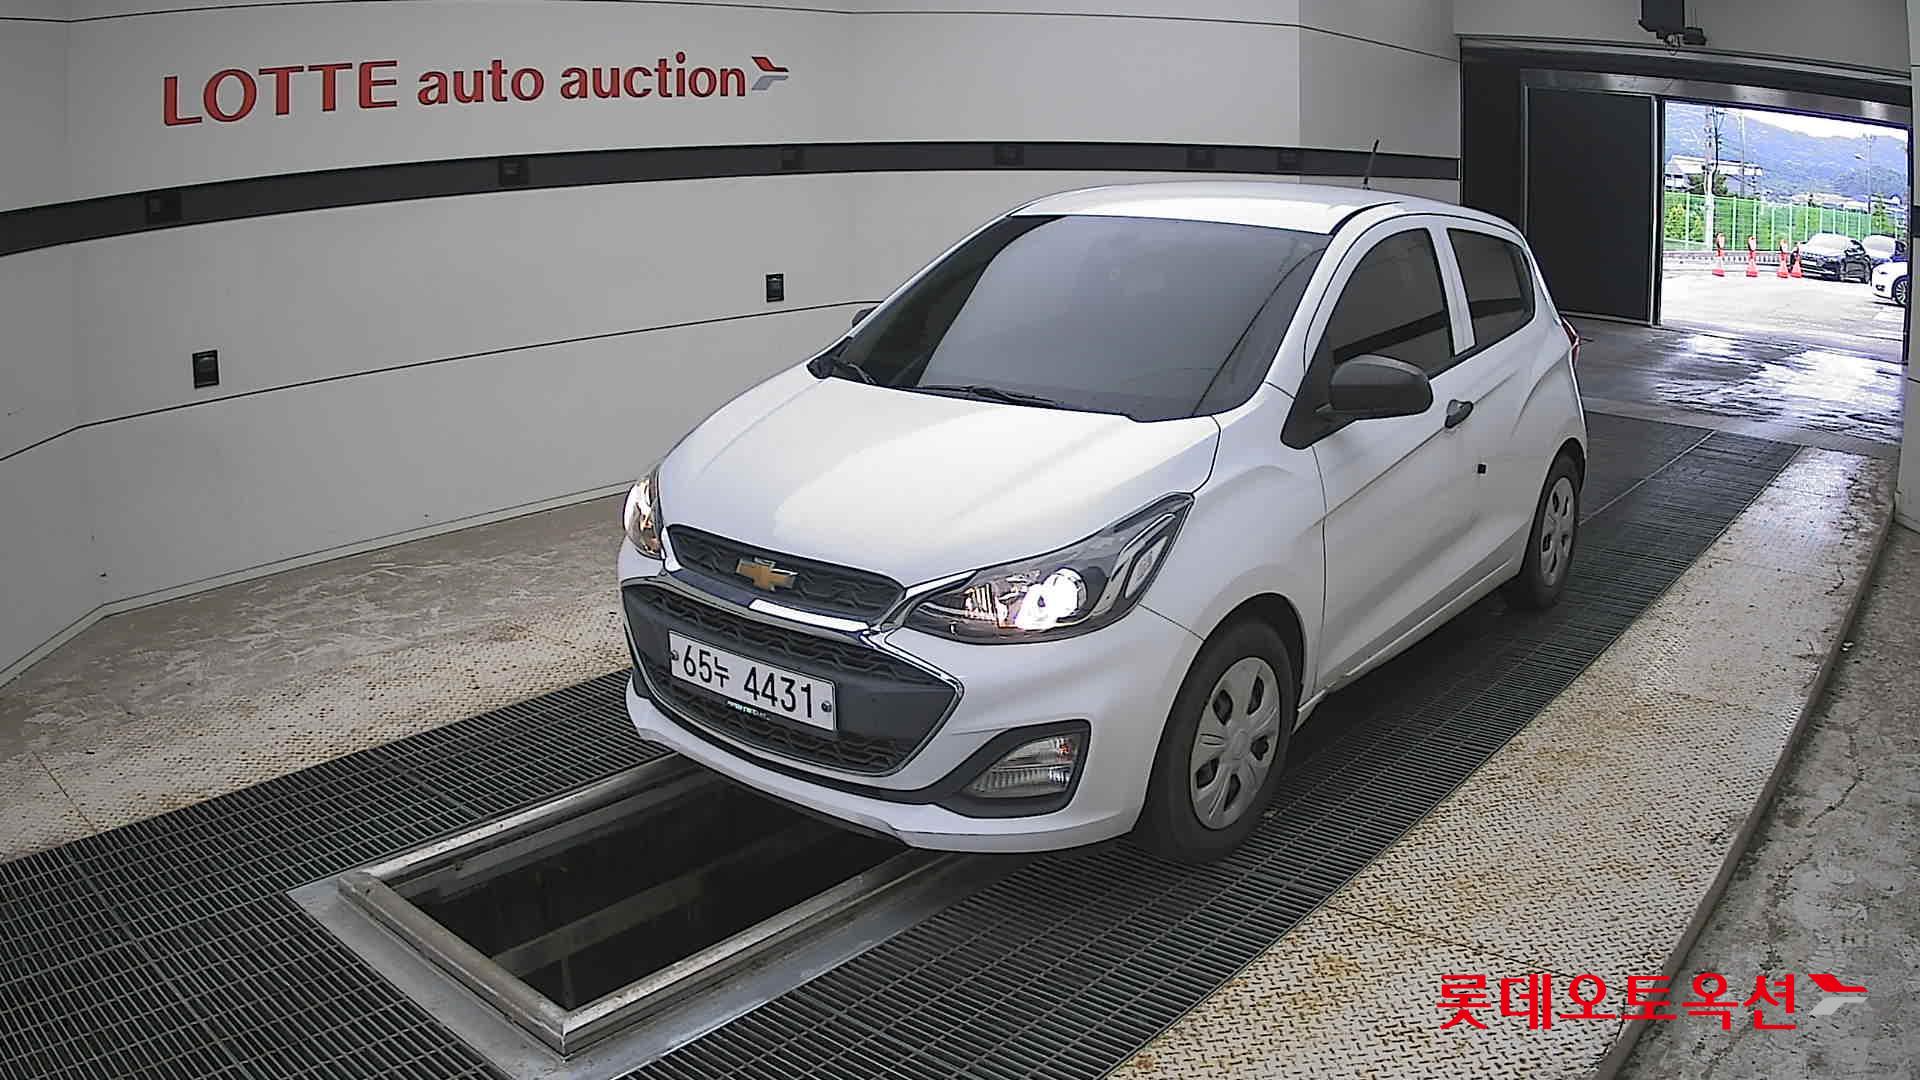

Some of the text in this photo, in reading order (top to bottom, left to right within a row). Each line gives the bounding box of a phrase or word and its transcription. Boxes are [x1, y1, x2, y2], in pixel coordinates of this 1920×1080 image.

[163, 51, 746, 126] LOTTE auto auction
[683, 644, 730, 688] 65누
[743, 666, 813, 718] 4431
